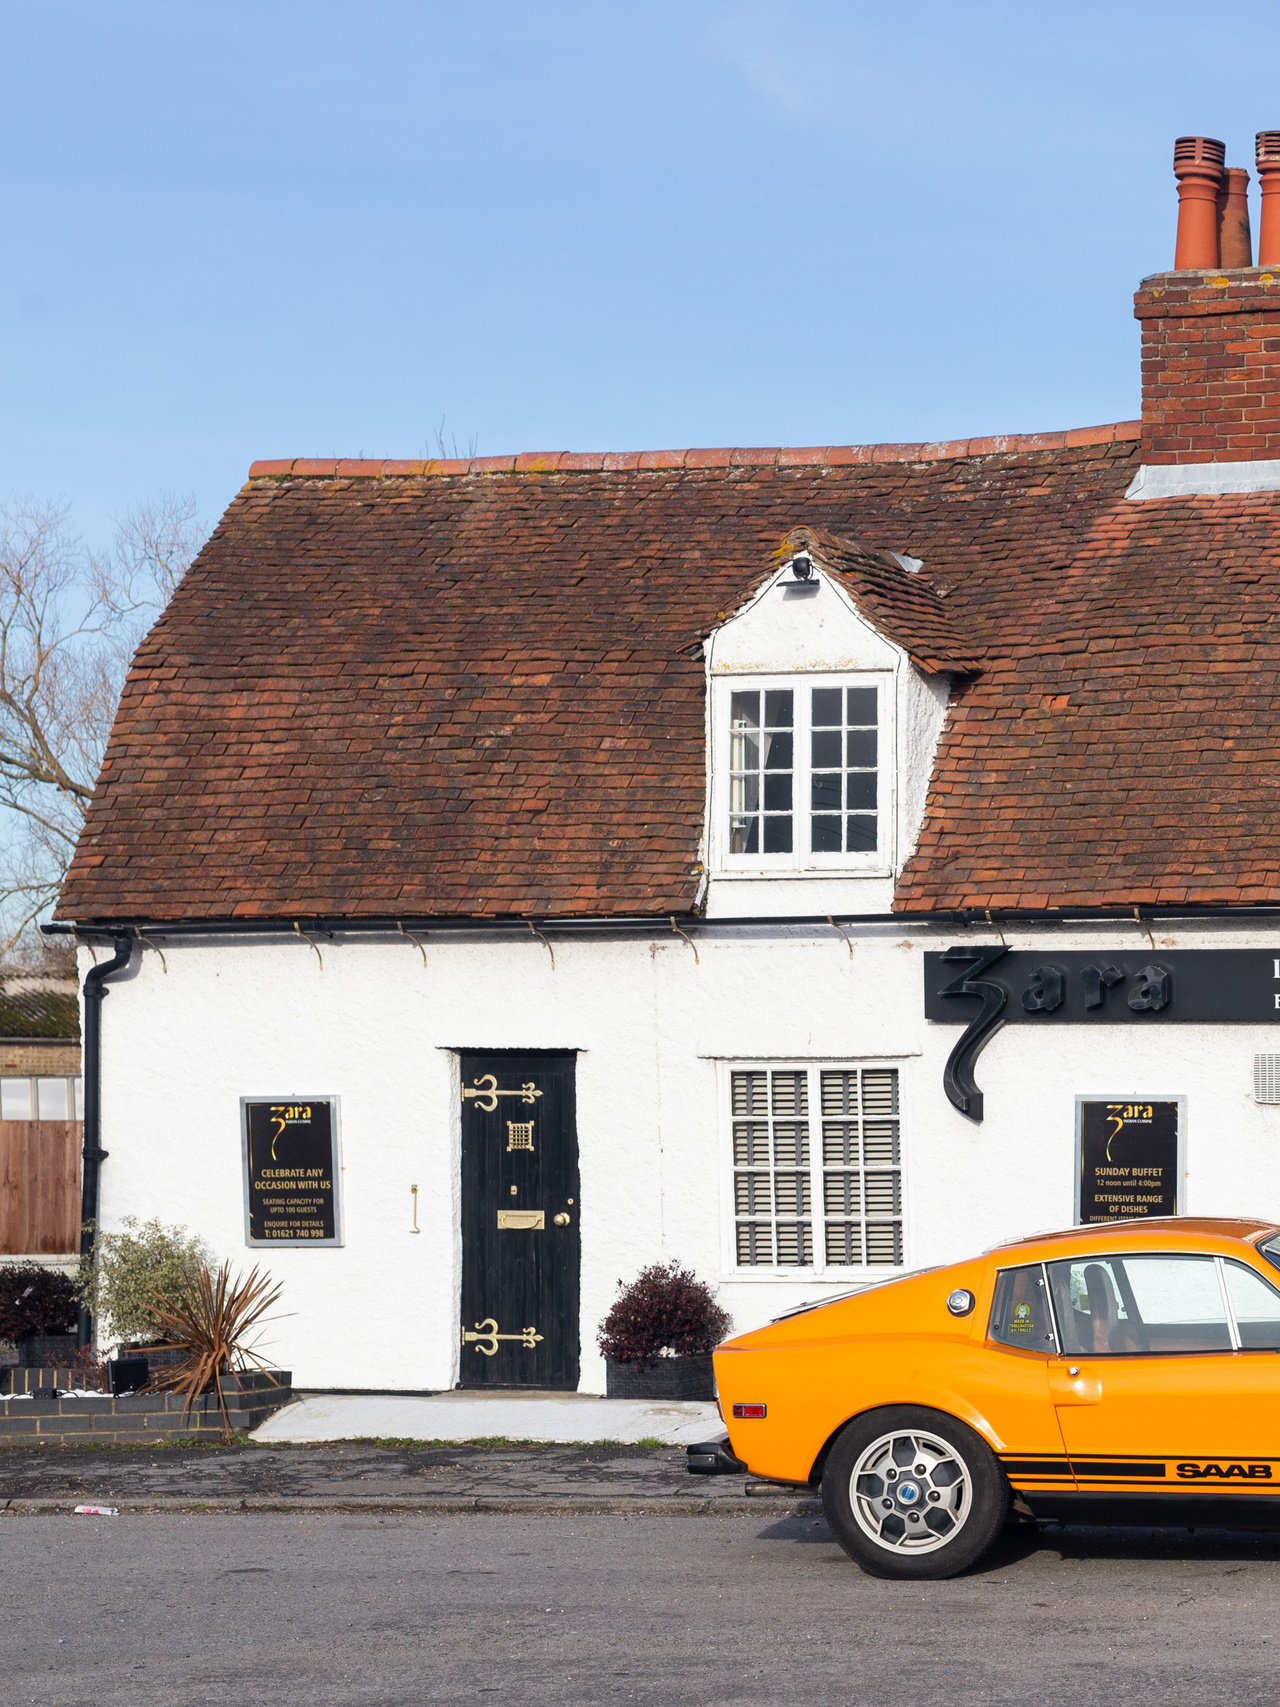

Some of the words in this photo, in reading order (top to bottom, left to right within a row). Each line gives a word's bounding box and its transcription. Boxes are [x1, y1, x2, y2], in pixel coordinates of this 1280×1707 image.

[261, 1169, 304, 1177] CELEBRATE
[306, 1169, 323, 1177] ANY
[1132, 1168, 1162, 1176] BUFFET
[255, 1181, 296, 1189] OCCASION
[298, 1181, 318, 1189] WITH
[320, 1181, 331, 1189] US
[311, 1229, 324, 1237] 998
[1176, 1463, 1272, 1479] SAAB
